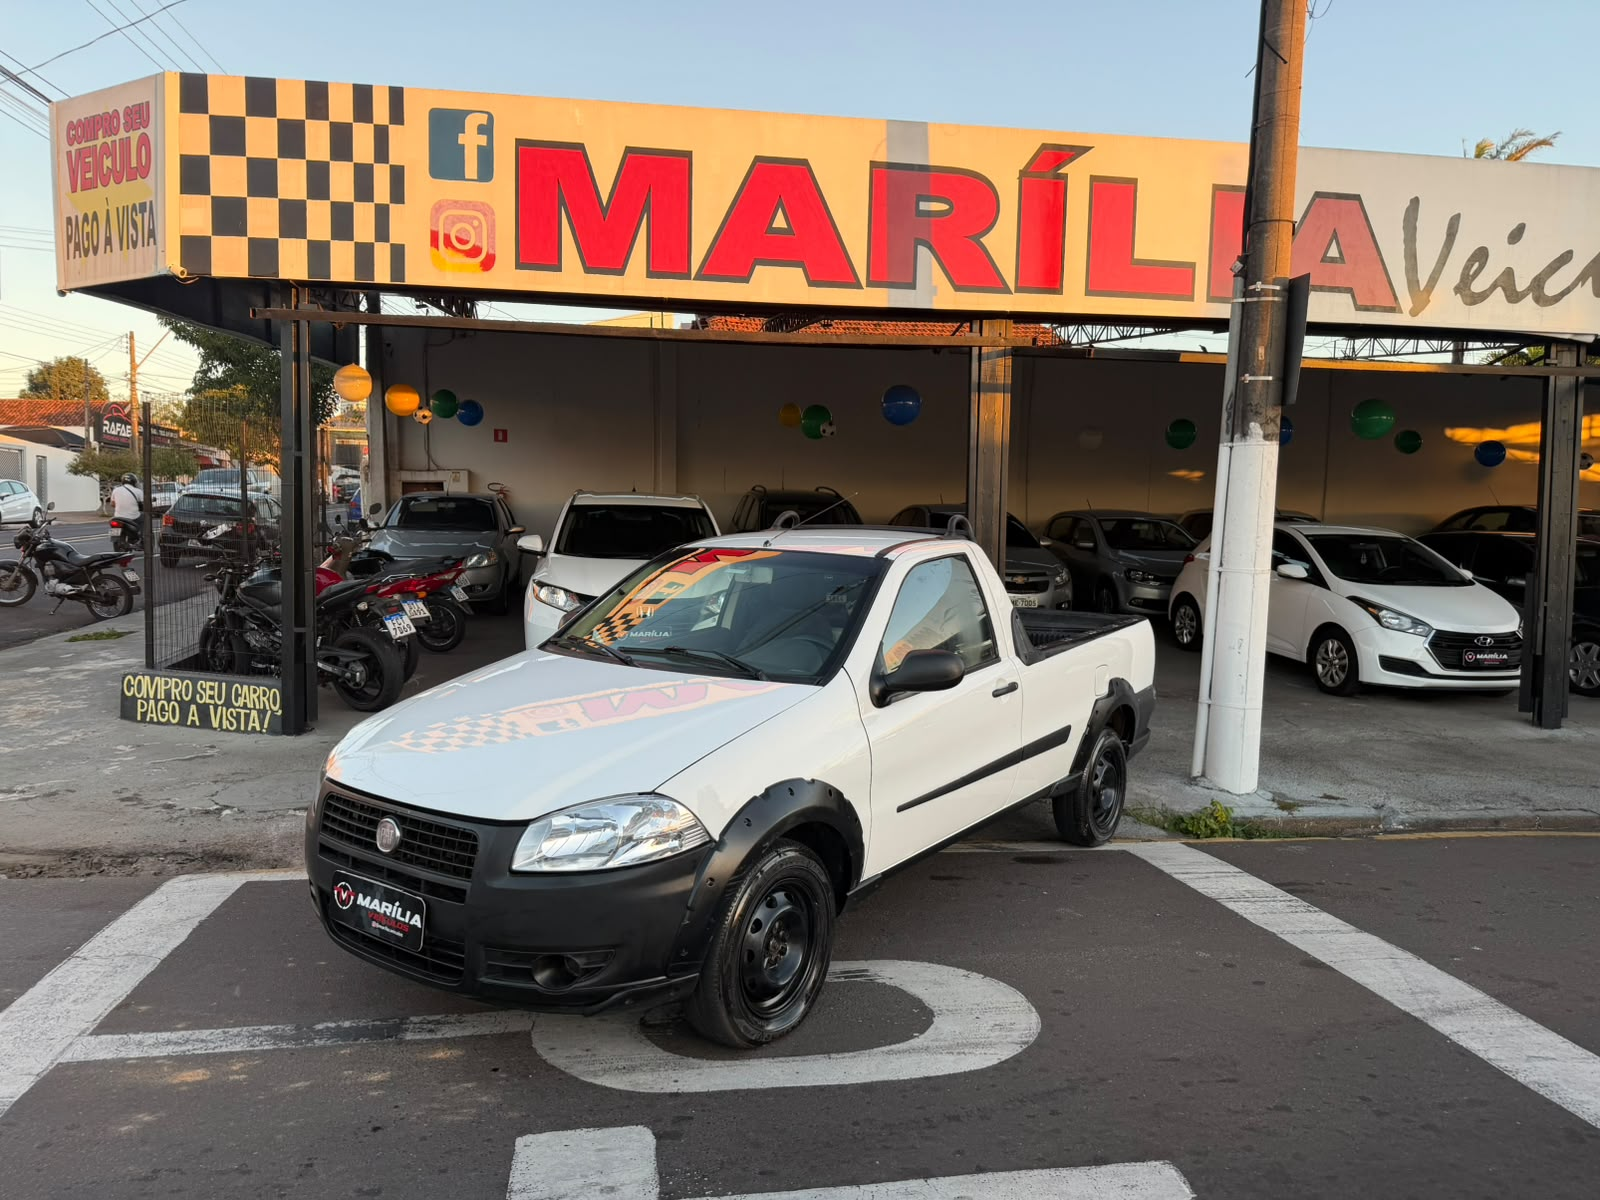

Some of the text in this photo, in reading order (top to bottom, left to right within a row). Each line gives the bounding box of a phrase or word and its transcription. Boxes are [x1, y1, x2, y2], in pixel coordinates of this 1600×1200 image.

[66, 101, 150, 146] COMPRO SEU
[66, 132, 151, 193] VEICULO
[66, 197, 157, 260] PAGO À VISTA
[514, 138, 1600, 318] MARÍLIA Veic
[103, 420, 133, 437] RAFAE
[630, 630, 669, 638] MARÍLIA
[123, 675, 192, 702] COMPRO
[196, 680, 226, 705] SEU
[137, 699, 271, 733] PAGO A VISTA!
[356, 893, 422, 928] MARÍLIA
